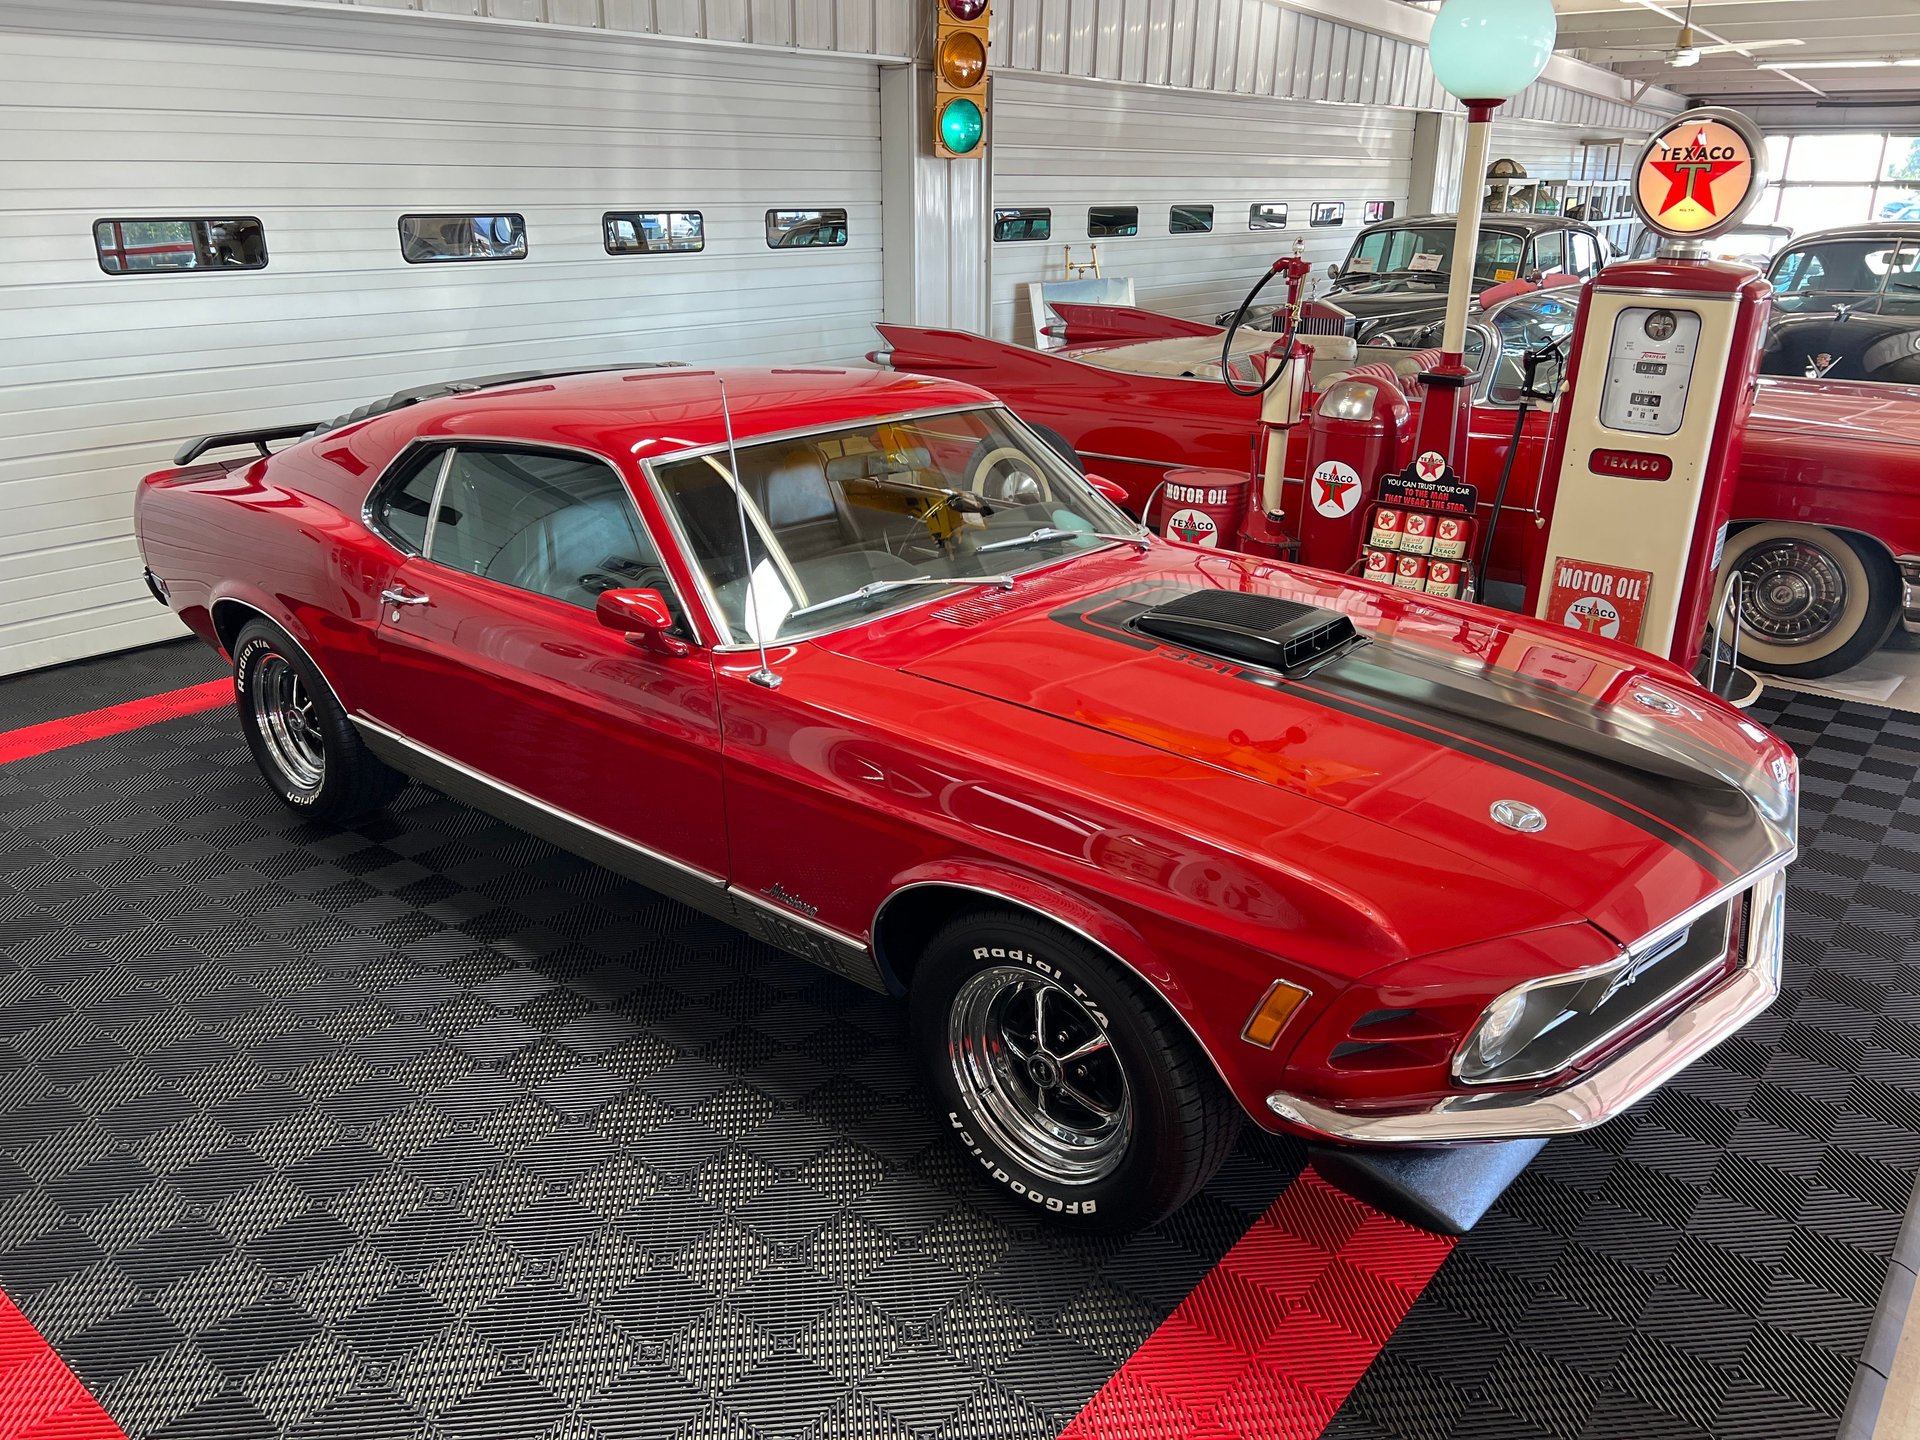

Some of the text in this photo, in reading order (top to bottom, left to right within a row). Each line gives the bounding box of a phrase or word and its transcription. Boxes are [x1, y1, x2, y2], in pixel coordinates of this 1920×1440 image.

[1660, 146, 1736, 162] TEXACO
[1603, 455, 1661, 472] TEXACO
[1318, 471, 1353, 483] TEXACO
[1166, 482, 1228, 505] MOTOR OIL
[1387, 478, 1470, 496] YOU CAN TRUST YOUR CAR
[1404, 487, 1449, 501] TO THE MAN
[1384, 493, 1403, 503] THAT
[1403, 496, 1430, 508] WEARS
[1431, 500, 1445, 510] THE
[1172, 518, 1214, 531] TEXACO
[1558, 567, 1641, 601] MOTOR OIL
[1574, 604, 1616, 620] TEXACO
[237, 639, 271, 693] Radial T/A
[1159, 648, 1232, 673] 351
[973, 946, 1109, 1029] Radial T/A
[949, 1111, 1098, 1215] BFGoodrich
